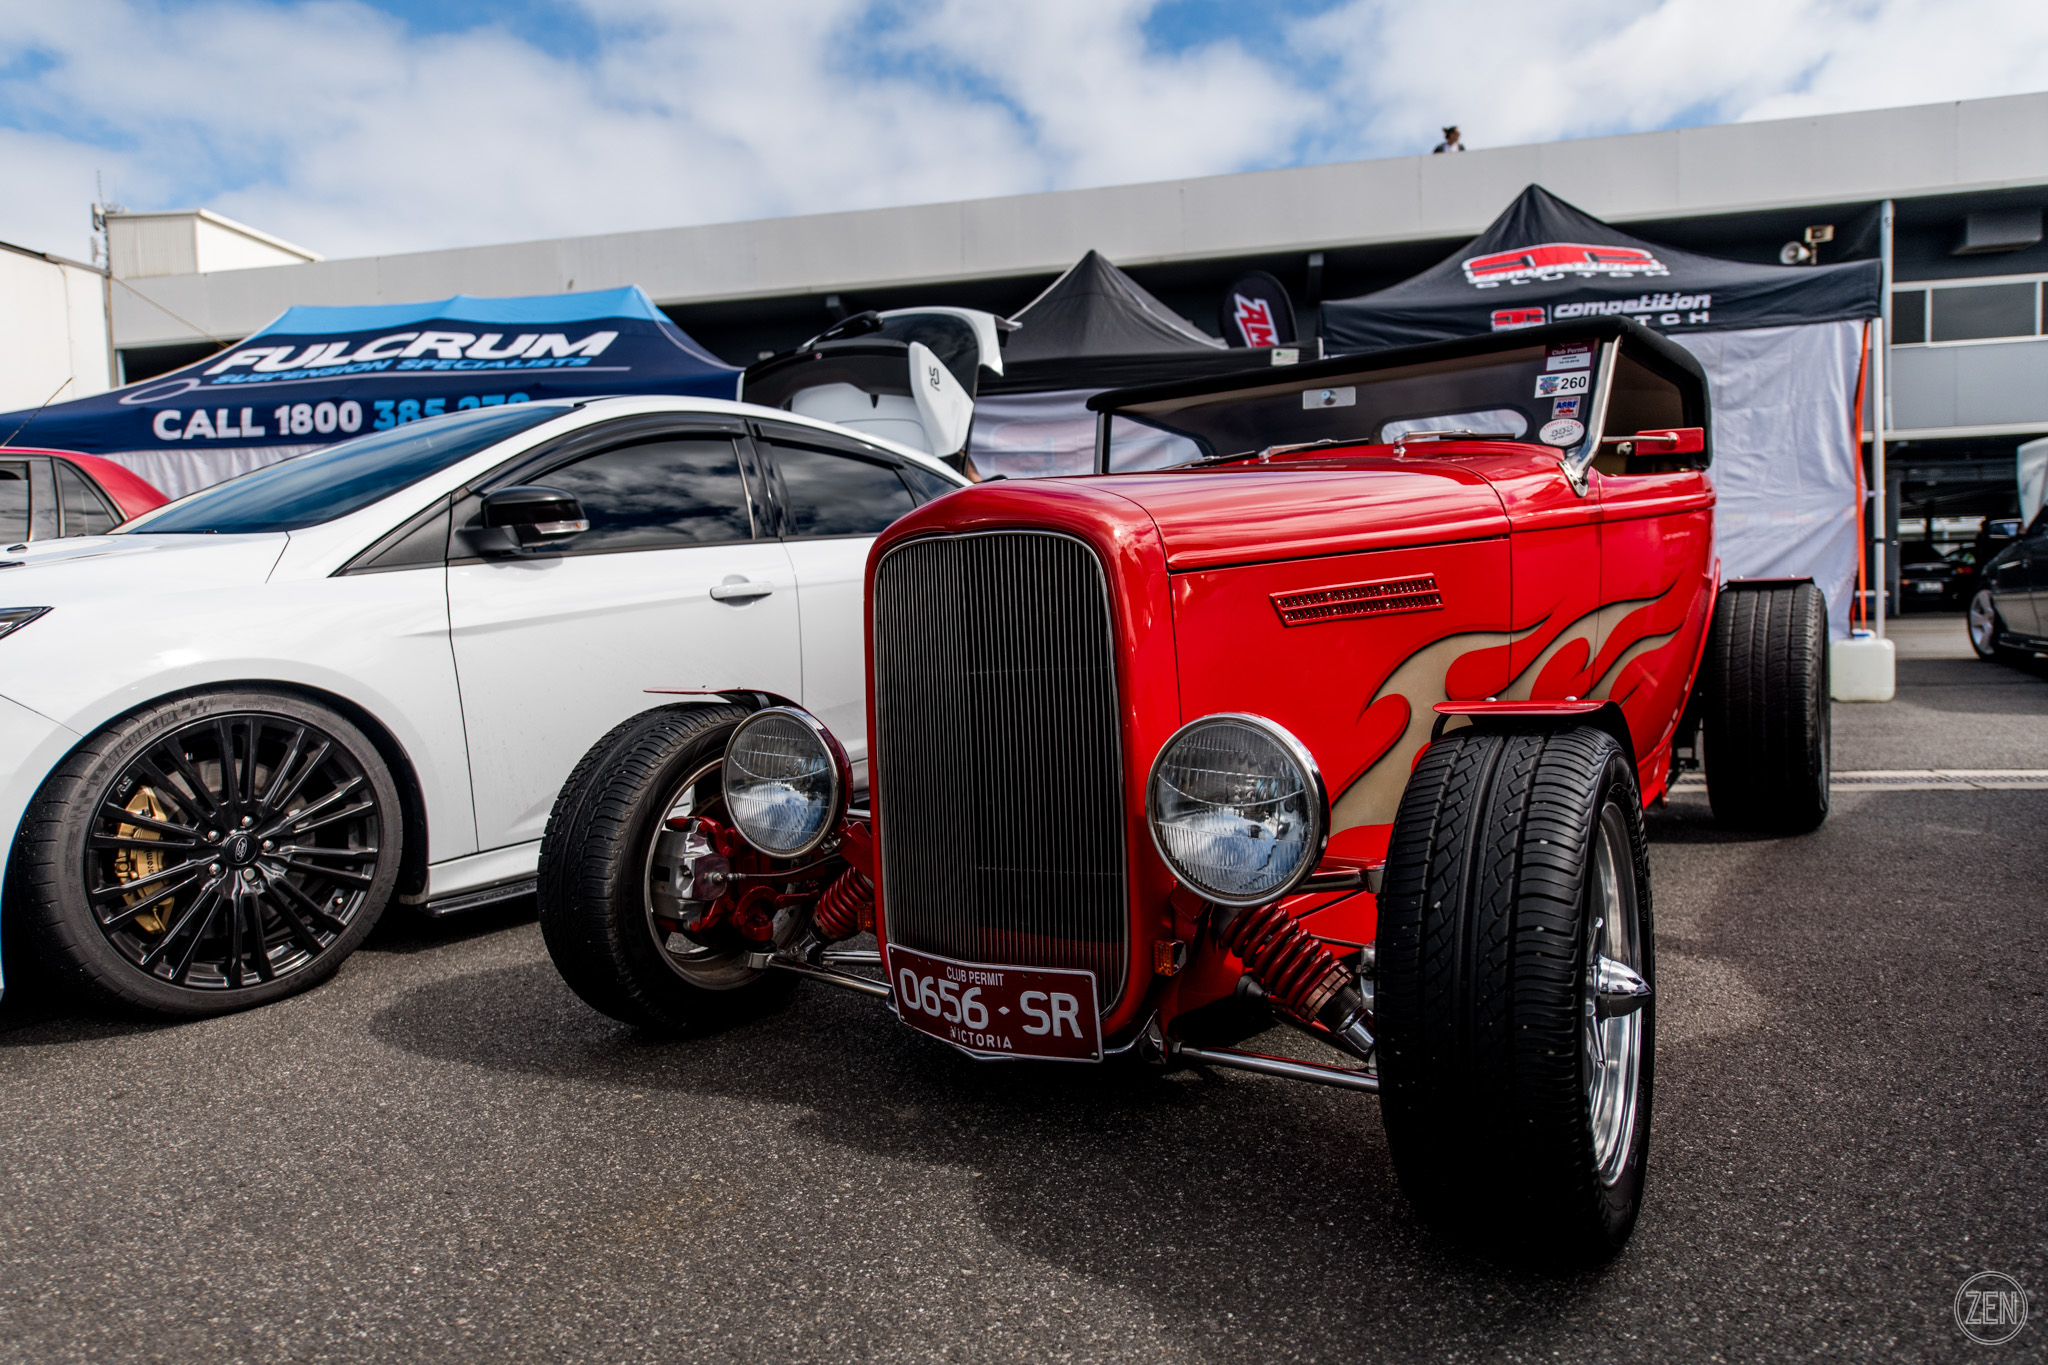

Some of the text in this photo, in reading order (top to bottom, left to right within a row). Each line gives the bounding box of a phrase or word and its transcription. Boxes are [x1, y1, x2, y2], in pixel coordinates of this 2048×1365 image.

[1554, 292, 1712, 318] competition
[202, 331, 620, 375] FULCRUM
[211, 357, 592, 385] SUSPENSION SPECIALISTS
[1560, 376, 1587, 390] 260
[152, 406, 266, 441] CALL
[274, 400, 363, 436] 1800
[104, 711, 176, 769] MICHELIN
[946, 966, 1004, 987] CLUB PERMIT
[900, 968, 1084, 1039] 0656 SR
[949, 1026, 1013, 1050] VICTORIA
